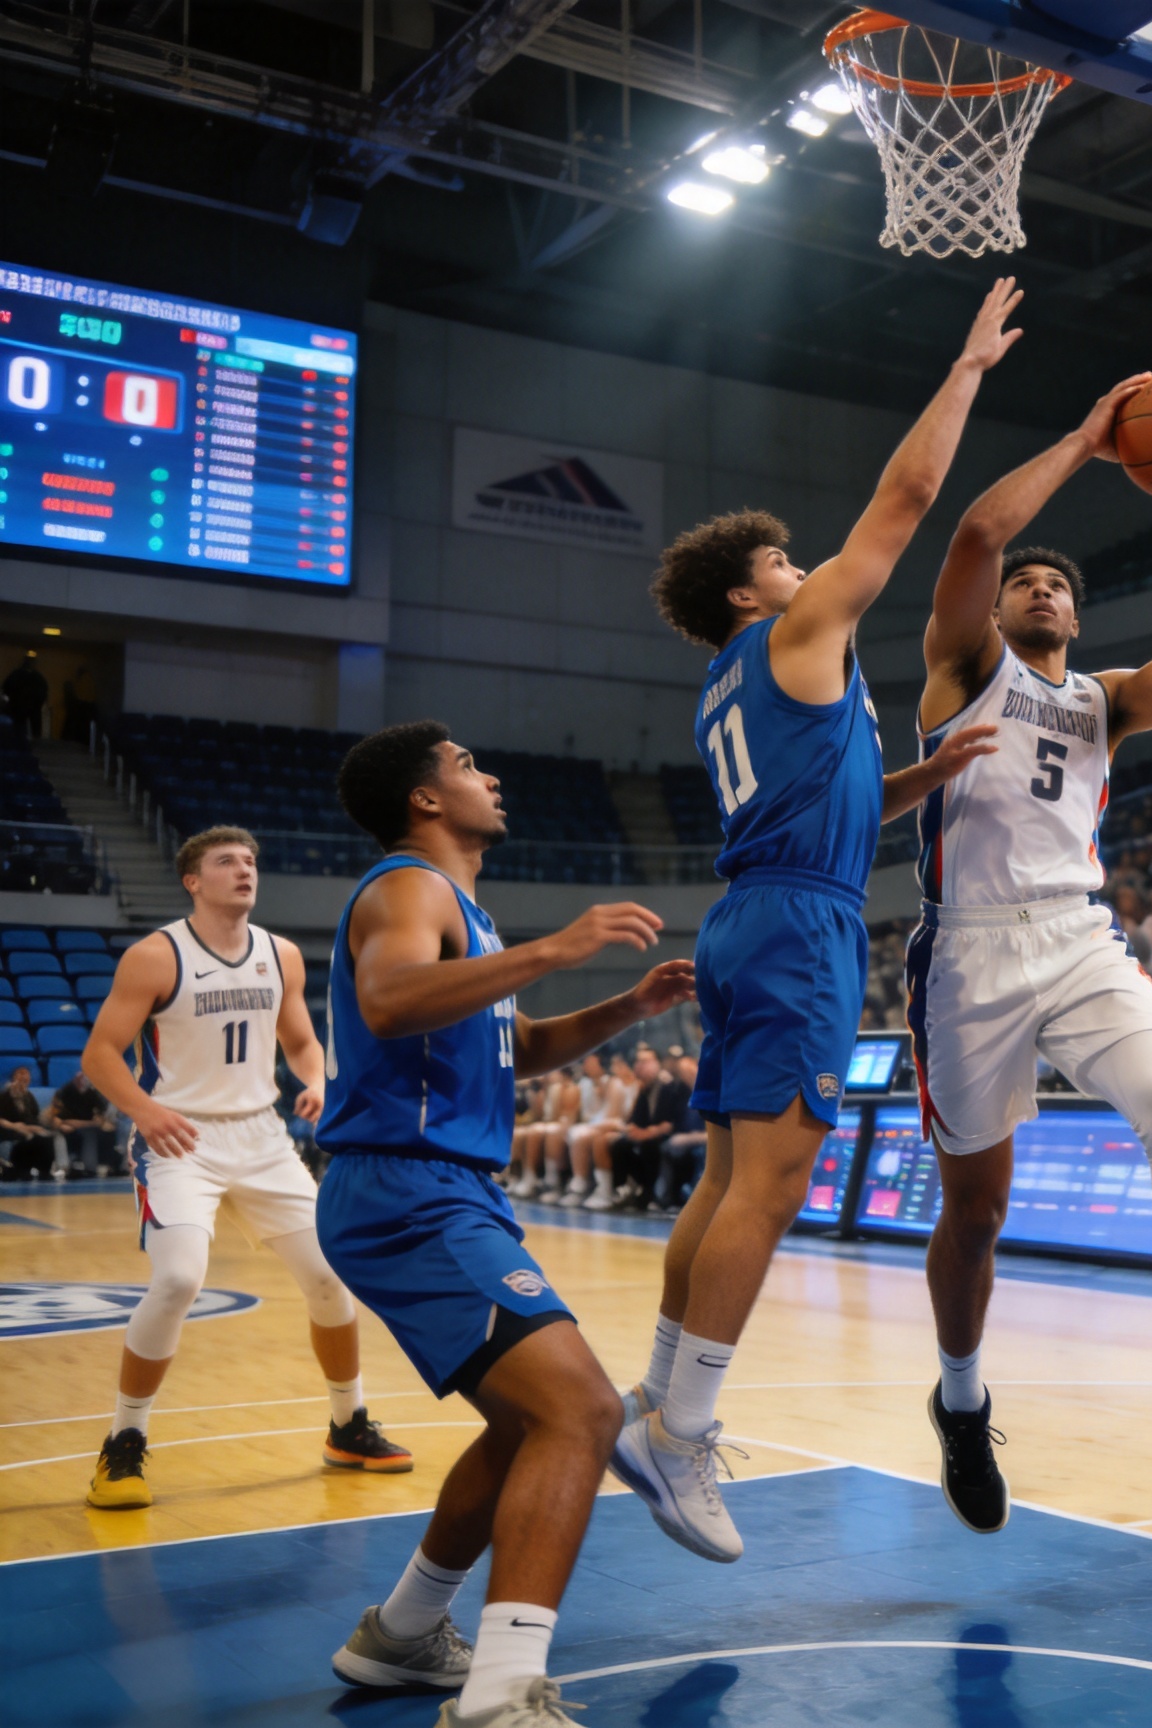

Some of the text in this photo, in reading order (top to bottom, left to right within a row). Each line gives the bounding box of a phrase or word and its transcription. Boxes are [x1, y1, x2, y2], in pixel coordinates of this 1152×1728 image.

[8, 356, 50, 410] 0
[122, 375, 158, 427] 0
[707, 703, 759, 816] 11
[1030, 736, 1068, 802] 5
[222, 1020, 248, 1064] 11
